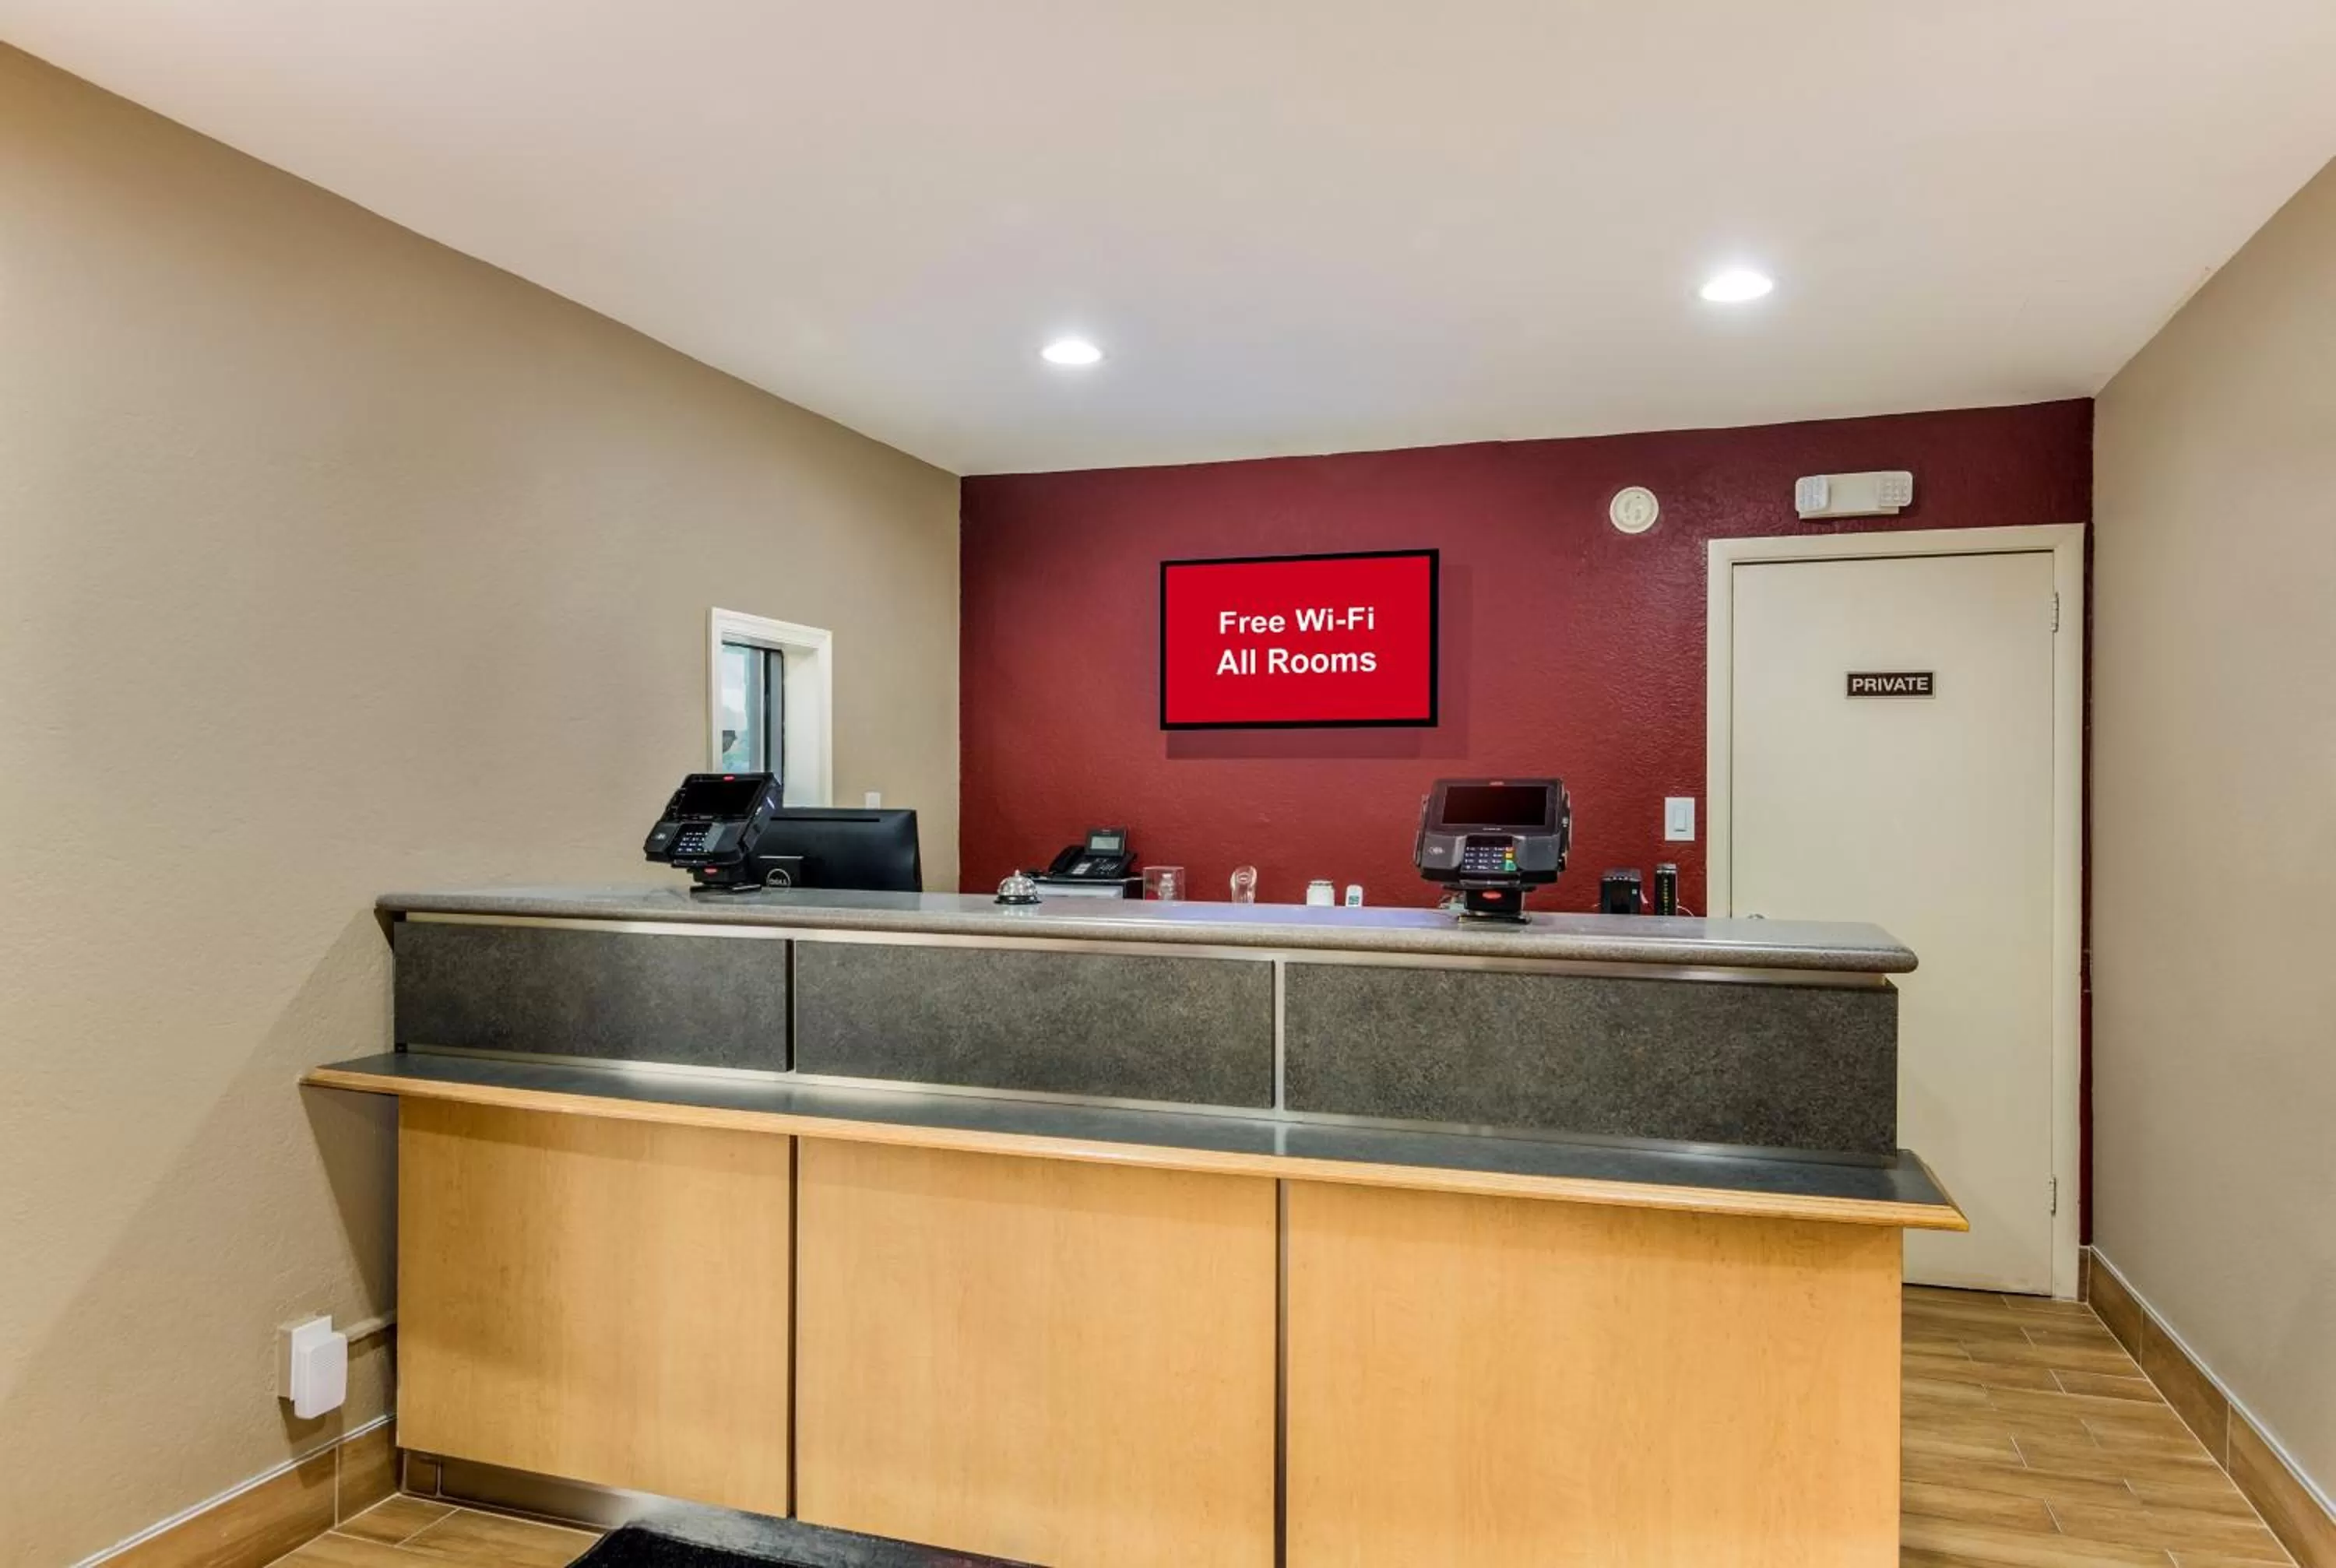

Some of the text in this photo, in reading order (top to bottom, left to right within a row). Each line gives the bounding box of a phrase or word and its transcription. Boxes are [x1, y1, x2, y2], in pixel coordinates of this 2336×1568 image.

[1219, 606, 1374, 635] Free Wi-Fi
[1216, 648, 1377, 676] All Rooms
[1852, 677, 1928, 692] PRIVATE
